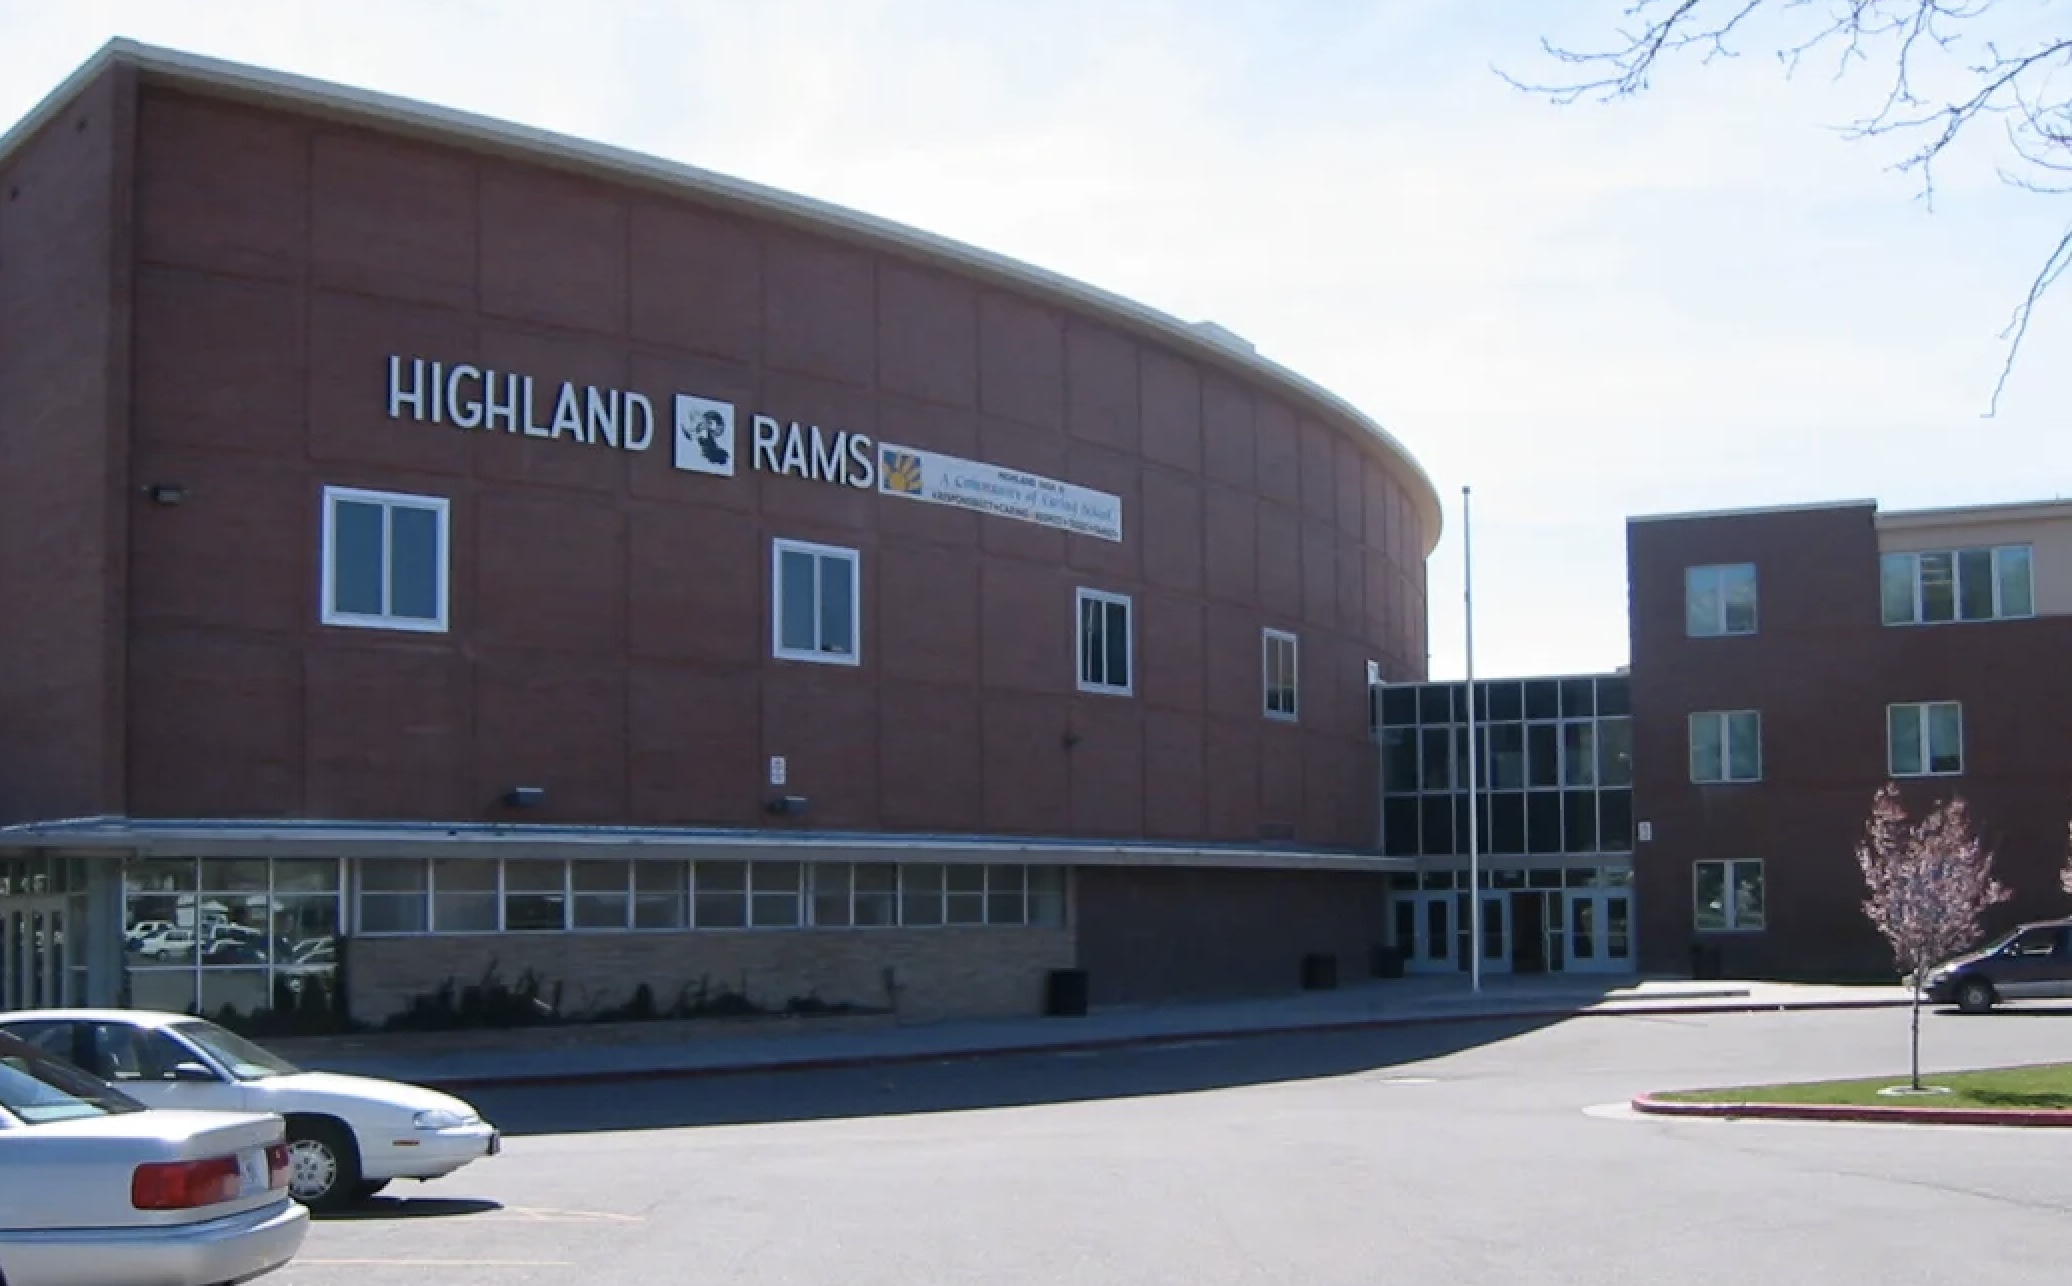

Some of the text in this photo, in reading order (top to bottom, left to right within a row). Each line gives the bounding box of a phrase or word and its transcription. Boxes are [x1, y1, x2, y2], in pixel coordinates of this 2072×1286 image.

[388, 355, 874, 489] HIGHLAND RAMS
[940, 473, 950, 488] A
